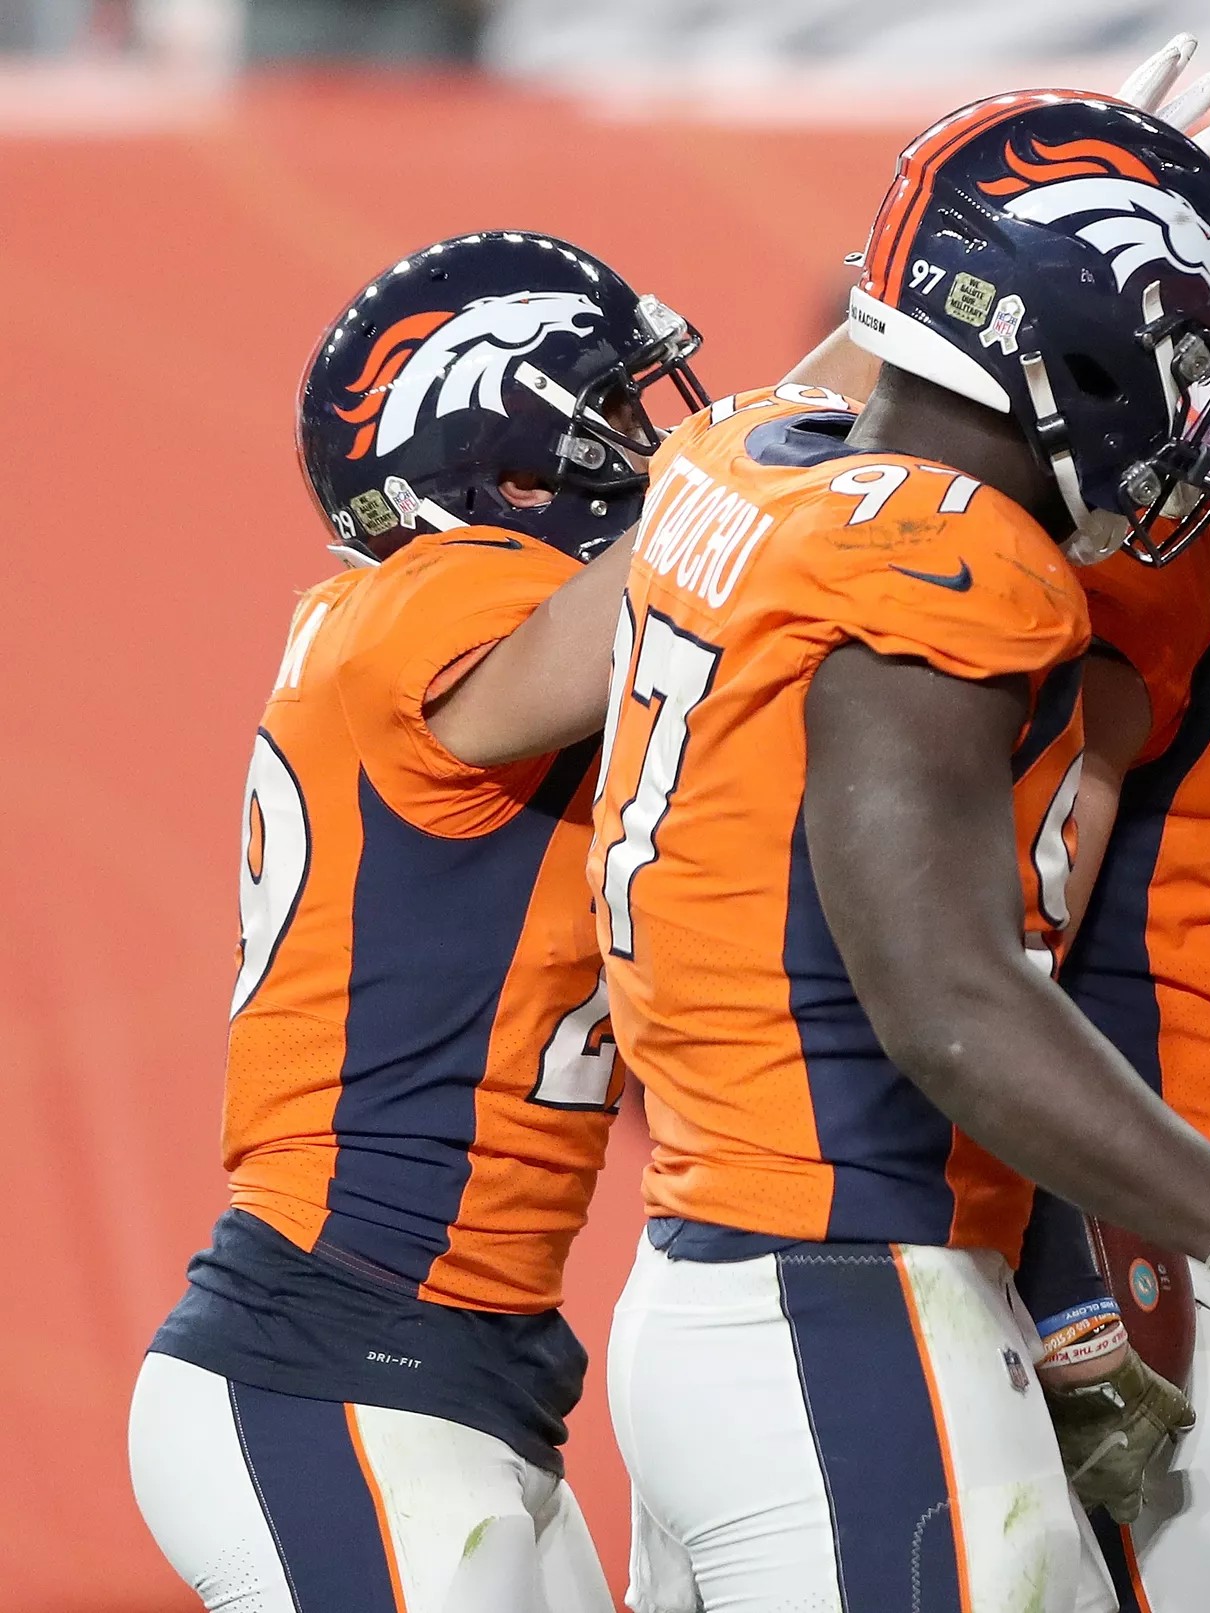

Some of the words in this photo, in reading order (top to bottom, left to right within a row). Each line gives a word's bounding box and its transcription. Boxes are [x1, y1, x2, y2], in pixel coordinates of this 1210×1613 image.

[909, 259, 947, 295] 97
[960, 284, 985, 300] SALUTE
[951, 299, 983, 318] MILITARY
[858, 309, 886, 335] RACISM
[829, 462, 983, 528] 97
[331, 510, 356, 539] 29
[524, 962, 621, 1115] 2
[1065, 1303, 1100, 1320] GLORY
[1072, 1346, 1094, 1358] THE
[1096, 1340, 1109, 1352] OF
[366, 1350, 422, 1369] DRI-FIT
